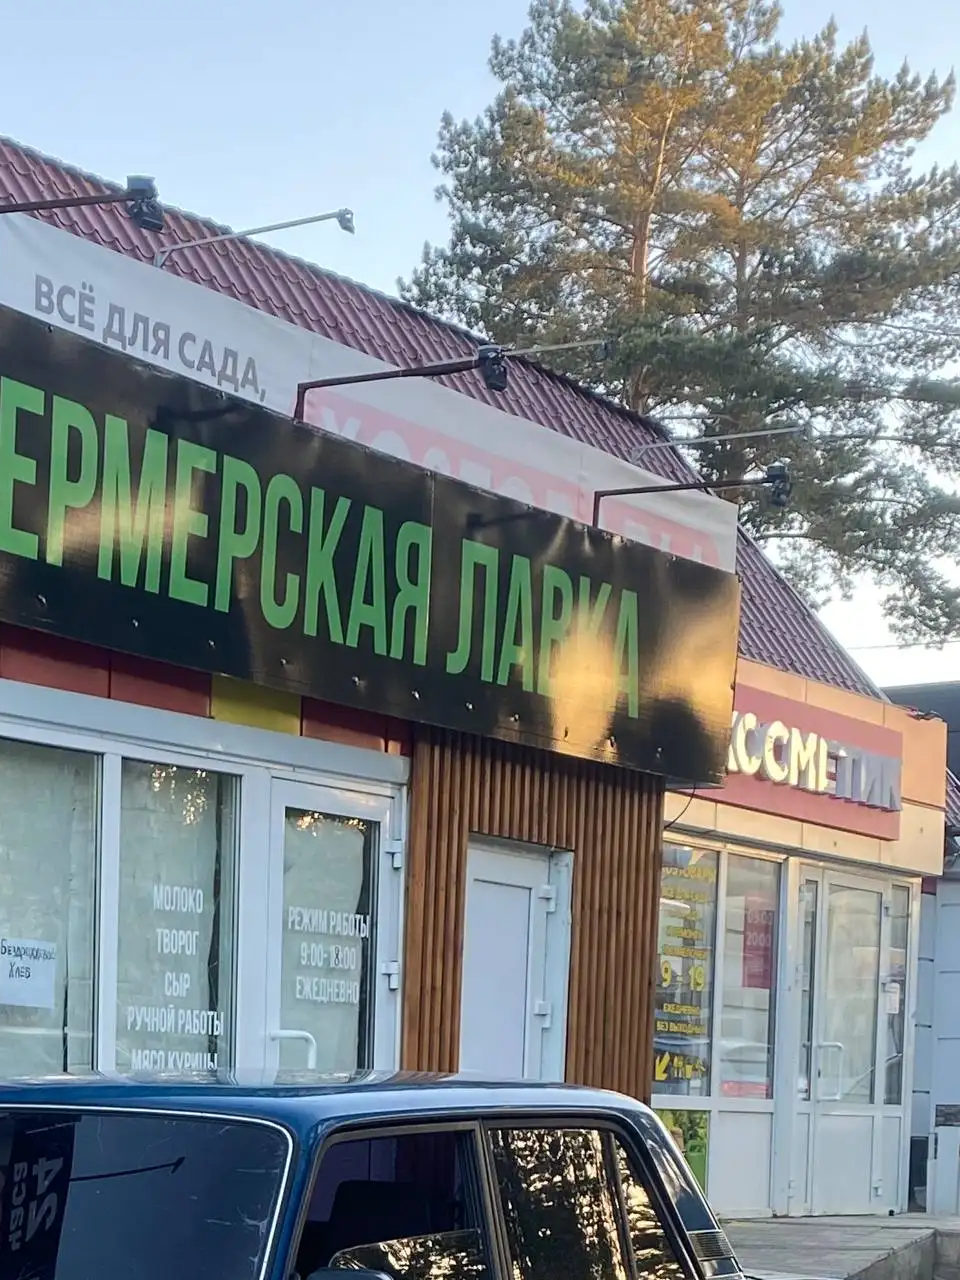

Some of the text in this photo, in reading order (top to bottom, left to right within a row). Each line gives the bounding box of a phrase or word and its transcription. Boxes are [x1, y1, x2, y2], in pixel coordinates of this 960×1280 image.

[35, 274, 267, 402] ВСЁ ДЛЯ САДА,
[446, 539, 639, 719] ЛАВКА
[153, 885, 203, 914] МОЛОКО
[288, 906, 370, 938] РЕЖИМ РАБОТЫ
[157, 928, 199, 955] ТВОРОГ
[165, 972, 190, 997] СЫР
[296, 976, 359, 1003] ЕЖЕДНЕВНО
[661, 960, 672, 987] 9
[689, 964, 705, 992] 19
[127, 1005, 224, 1036] РУЧНОЙ РАБОТЫ
[131, 1049, 218, 1071] МЯСО КУРИЦЫ
